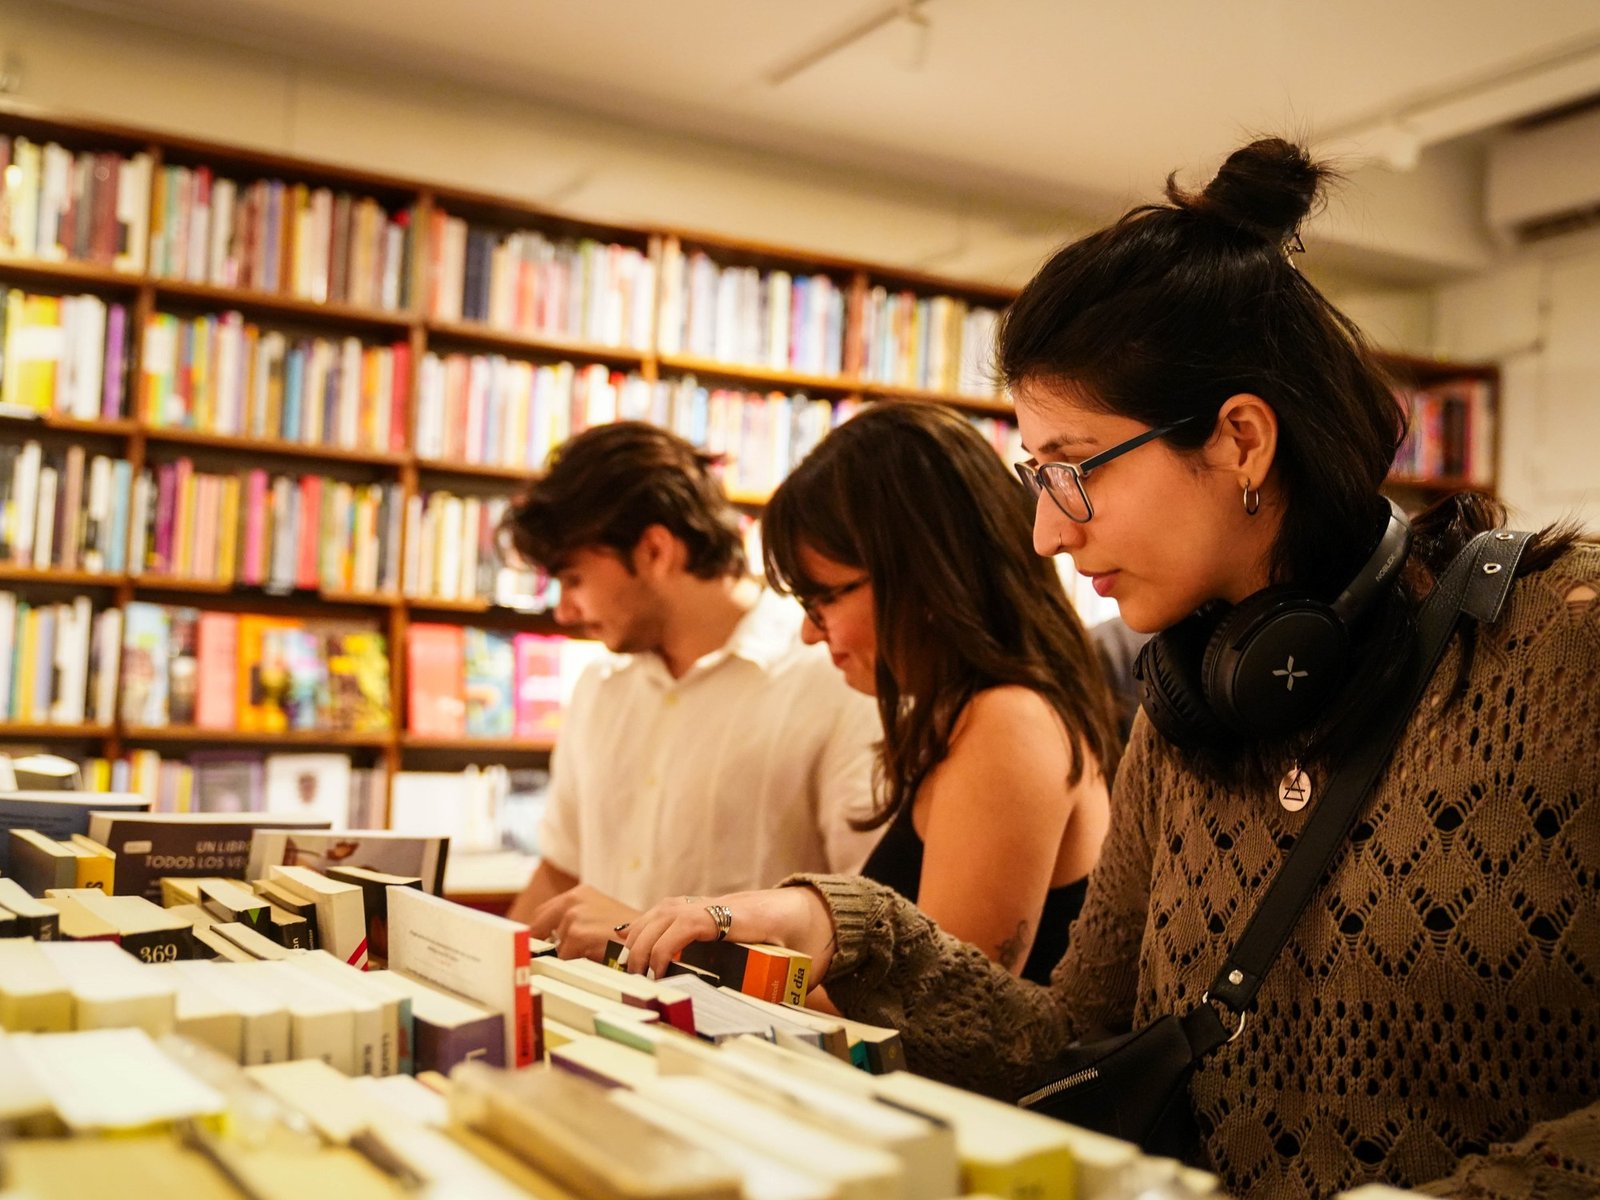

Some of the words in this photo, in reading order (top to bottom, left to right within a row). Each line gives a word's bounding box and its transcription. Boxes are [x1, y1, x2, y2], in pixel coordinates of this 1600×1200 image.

[196, 841, 216, 854] UN
[217, 840, 251, 853] LIBR
[145, 855, 196, 869] TODOS
[197, 855, 224, 869] LOS
[140, 943, 178, 963] 369
[790, 991, 800, 1006] el
